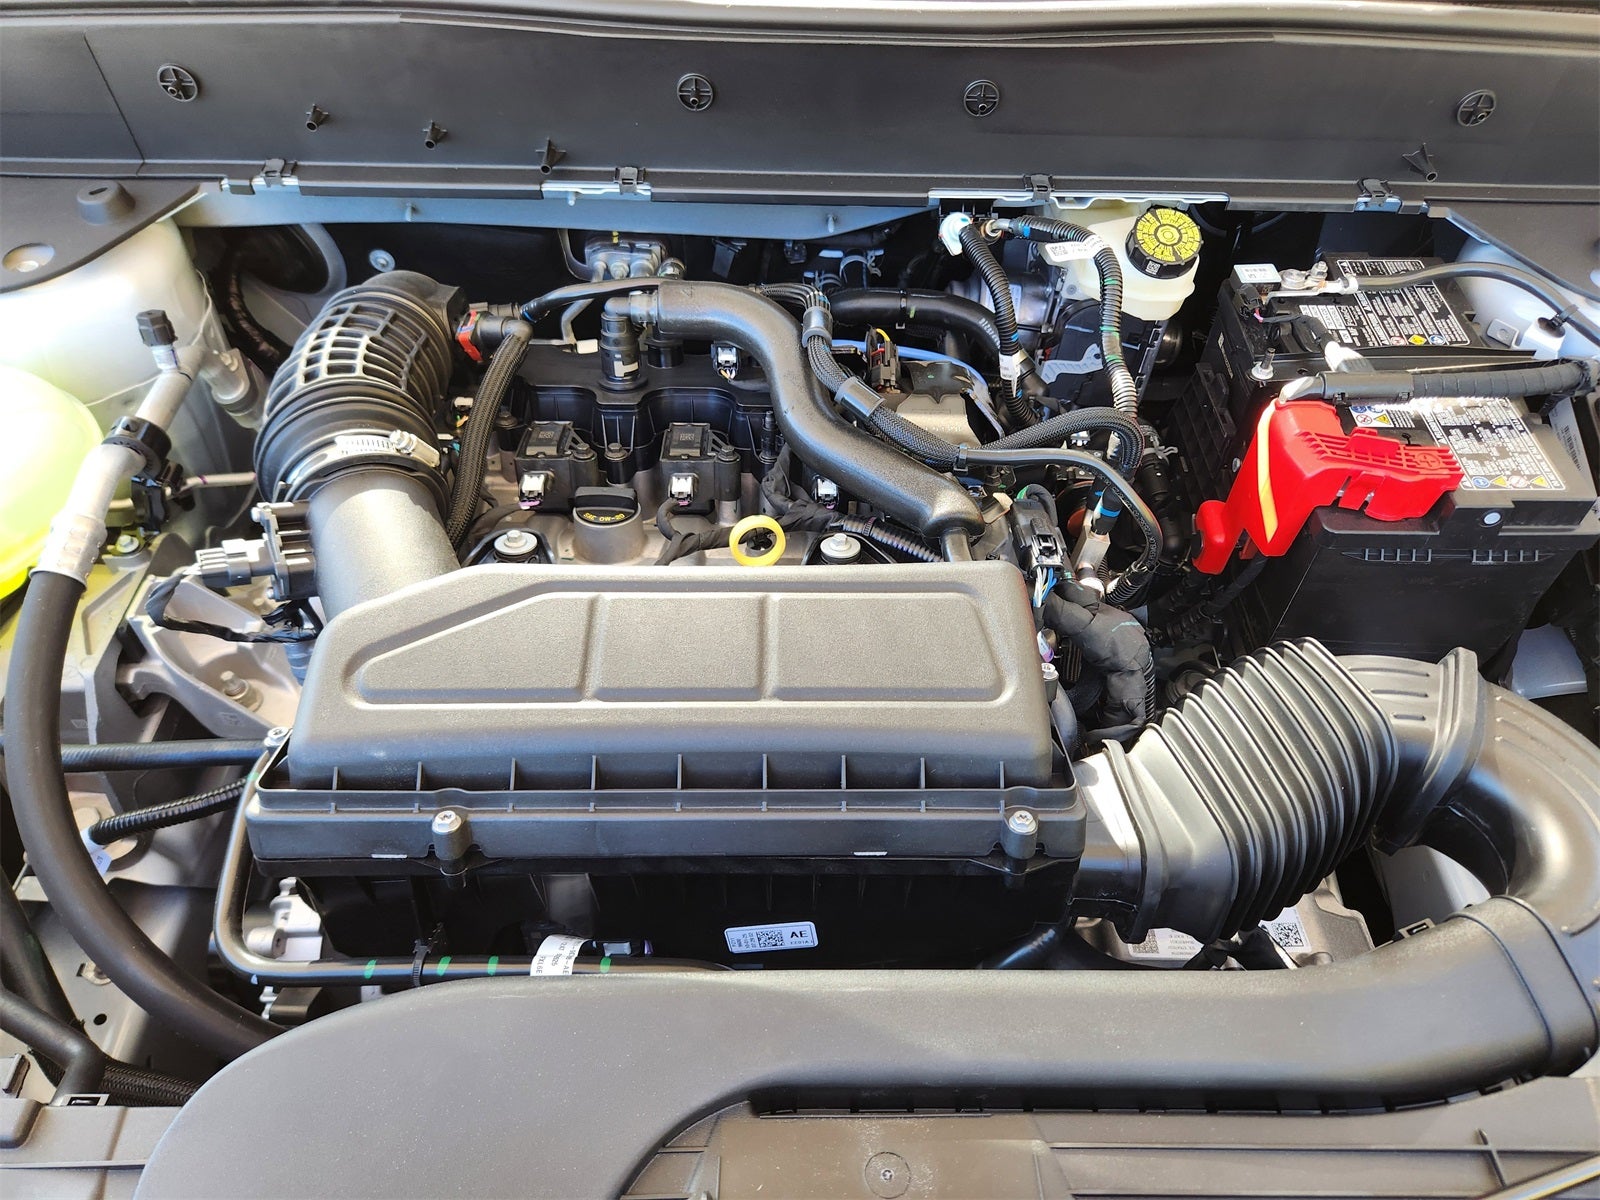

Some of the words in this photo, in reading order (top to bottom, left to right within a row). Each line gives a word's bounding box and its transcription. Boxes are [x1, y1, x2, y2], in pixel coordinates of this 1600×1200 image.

[583, 512, 596, 521] SAE
[599, 513, 625, 522] 0W-20
[790, 930, 808, 939] AE
